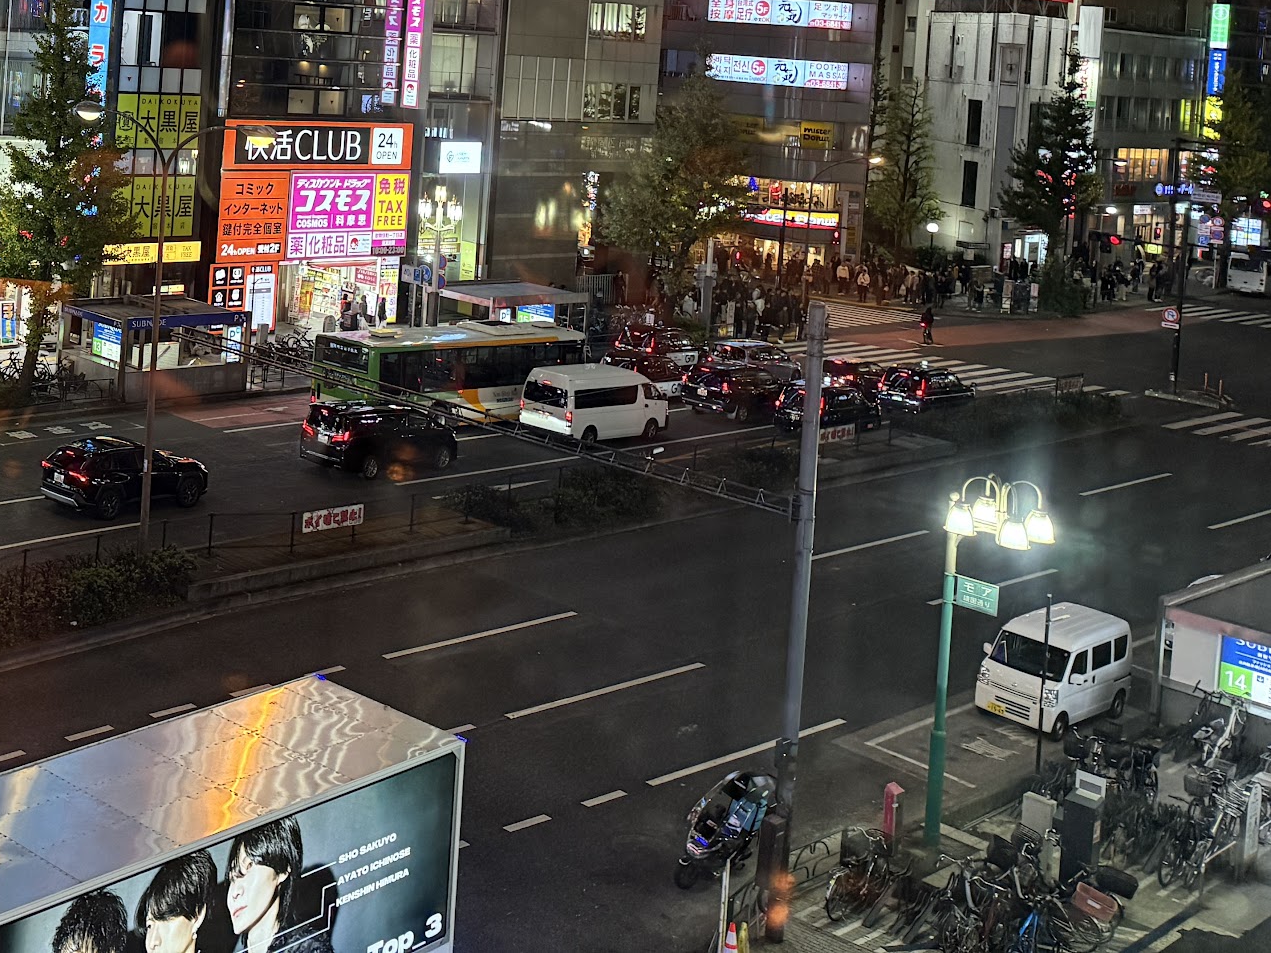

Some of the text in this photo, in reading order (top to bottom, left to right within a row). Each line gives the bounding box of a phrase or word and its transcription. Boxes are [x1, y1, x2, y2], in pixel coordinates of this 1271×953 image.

[756, 2, 769, 16] 5F
[408, 48, 418, 80] 化粧品
[751, 61, 765, 74] 5F
[141, 98, 198, 106] DAIKOKUYA
[139, 109, 198, 134] 大黒屋
[377, 132, 398, 149] 24h
[376, 150, 398, 160] OPEN
[235, 182, 275, 196] コミック
[296, 178, 372, 189] ディスカウント ドラッグ
[378, 177, 406, 195] 免税
[135, 195, 193, 219] 大黒屋
[224, 202, 283, 216] インターネット
[295, 189, 371, 213] コスモス
[378, 200, 403, 214] TAX
[296, 218, 328, 228] COSMOS
[376, 215, 403, 226] FREE
[222, 222, 283, 236] 鍵付完全個室
[289, 236, 304, 255] 薬
[309, 234, 345, 255] 化粧品
[93, 341, 102, 352] 13
[964, 581, 993, 597] モア
[1225, 671, 1247, 691] 14
[337, 832, 398, 864] SHO SAKUYO
[336, 846, 412, 886] AYATO ICHINOSE
[335, 867, 411, 907] KENSHIN HIMURA
